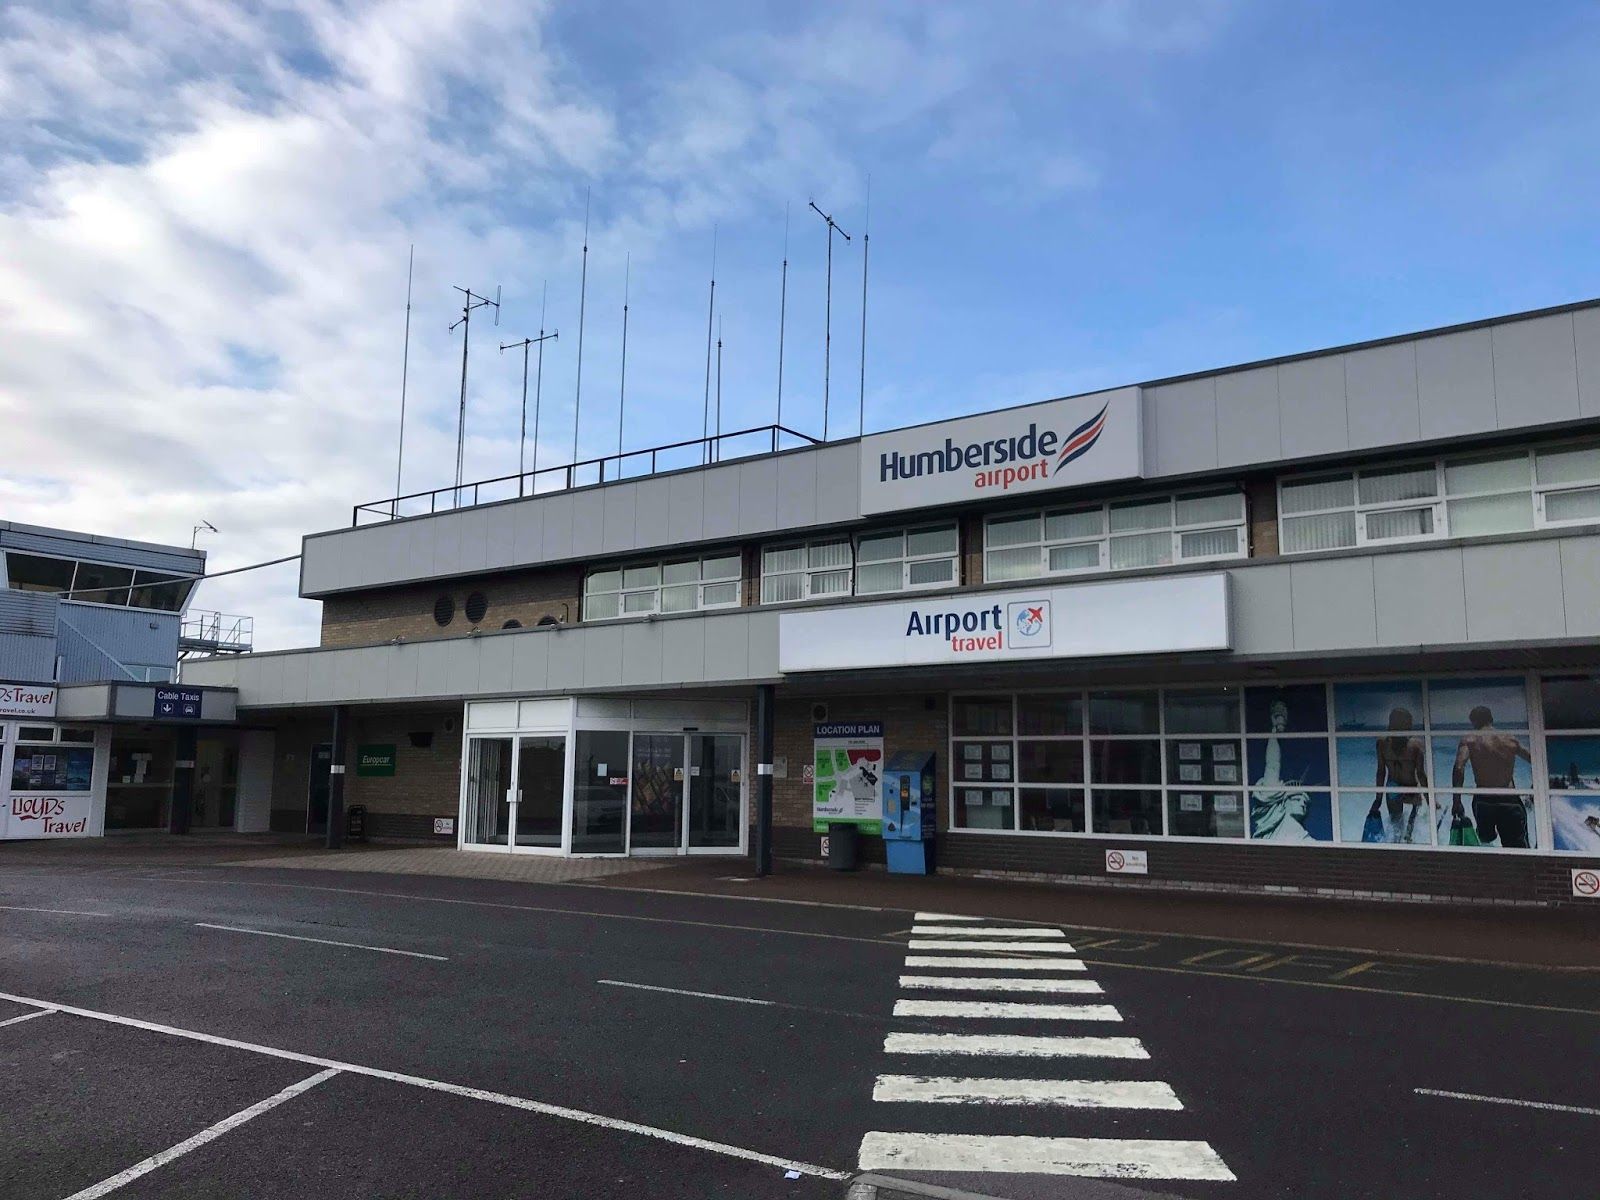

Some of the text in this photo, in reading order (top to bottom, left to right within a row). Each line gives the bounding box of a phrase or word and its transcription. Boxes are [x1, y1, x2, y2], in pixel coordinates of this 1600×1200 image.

[880, 423, 1058, 482] Humberside
[974, 458, 1048, 489] airport
[906, 604, 1003, 640] Airport
[951, 631, 1003, 652] travel
[13, 687, 54, 704] Travel
[180, 692, 200, 702] Taxis
[816, 724, 880, 735] LOCATION PLAN
[362, 754, 390, 765] Europcar
[42, 816, 86, 833] Travel
